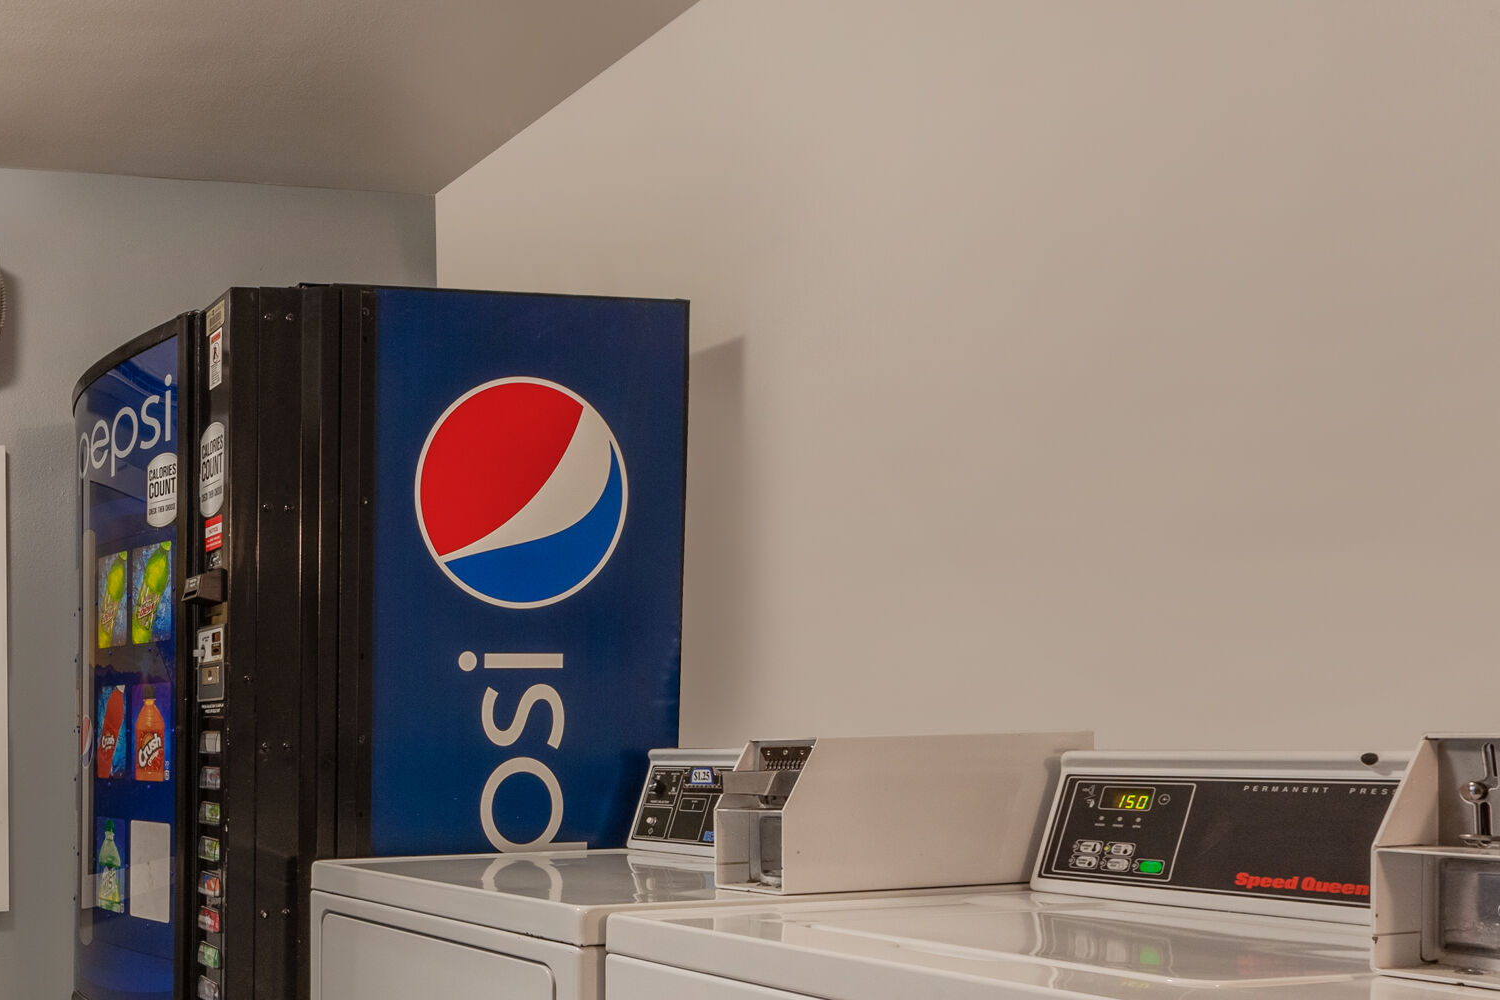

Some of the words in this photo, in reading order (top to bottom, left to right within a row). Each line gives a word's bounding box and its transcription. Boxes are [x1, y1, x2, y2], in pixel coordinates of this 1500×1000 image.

[78, 373, 172, 496] pepsi
[149, 462, 176, 481] CALORIES
[202, 452, 223, 482] COUNT
[149, 477, 176, 499] COUNT
[1243, 785, 1330, 794] PERMANENT
[1118, 794, 1150, 810] 150
[1234, 871, 1300, 889] Speed
[1301, 876, 1370, 896] Queen
